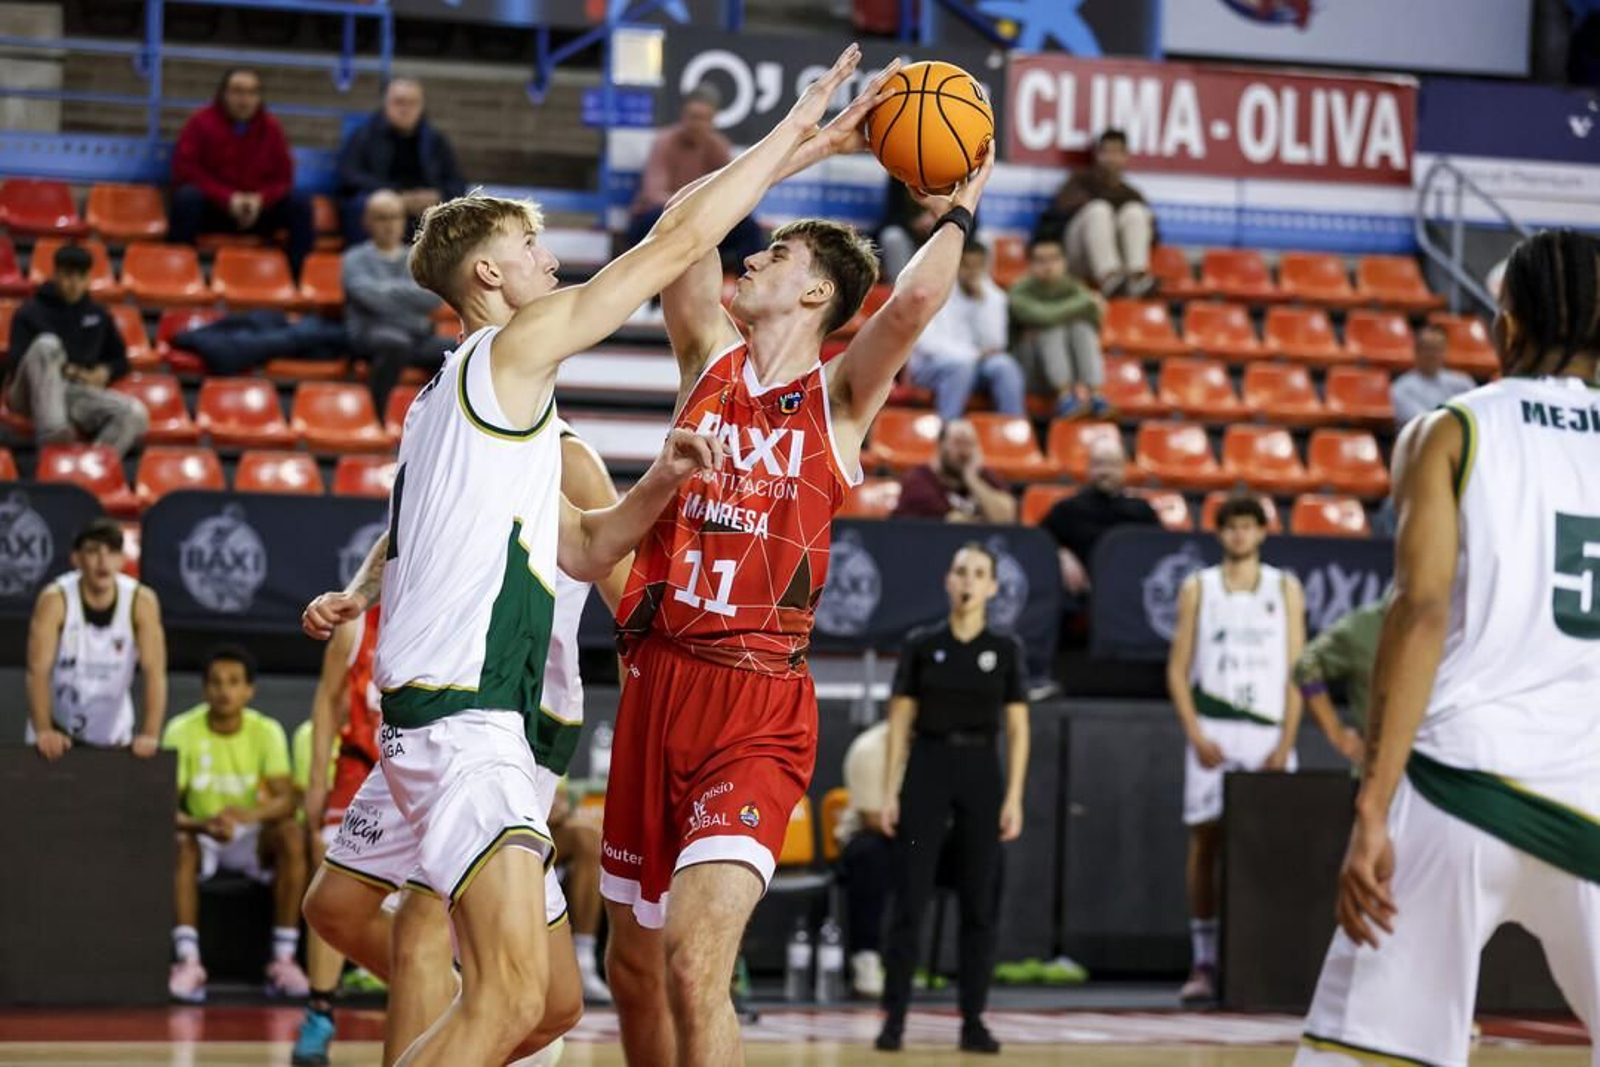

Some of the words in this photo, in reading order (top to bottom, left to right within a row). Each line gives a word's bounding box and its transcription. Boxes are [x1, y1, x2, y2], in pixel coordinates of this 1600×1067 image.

[1016, 67, 1206, 159] CLIMA
[1238, 82, 1408, 171] OLIVA
[696, 471, 798, 501] ATIZACIÓN
[187, 545, 261, 576] BAXI
[673, 550, 738, 617] 11
